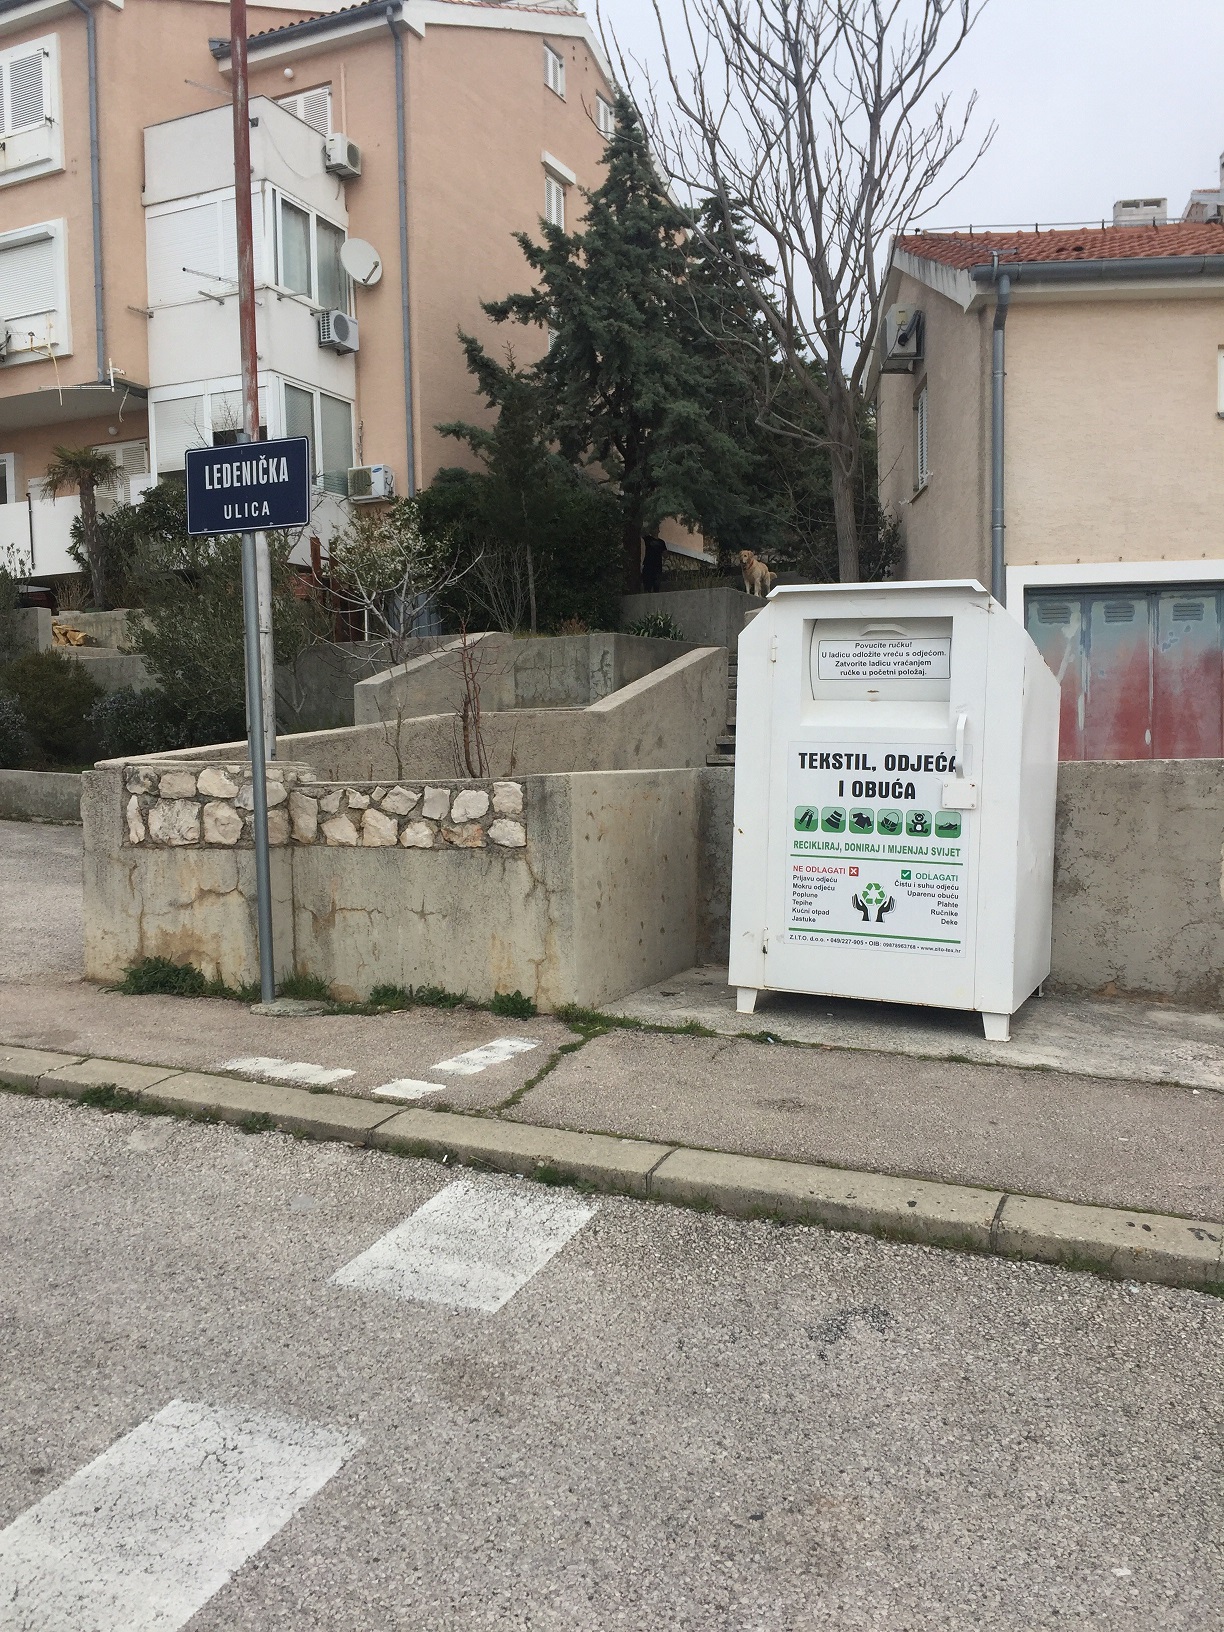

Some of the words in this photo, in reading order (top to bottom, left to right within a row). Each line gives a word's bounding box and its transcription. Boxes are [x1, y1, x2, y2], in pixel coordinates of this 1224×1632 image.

[205, 455, 288, 489] LEDENIČKA
[224, 501, 270, 519] ULICA
[912, 650, 946, 658] odjećom.
[869, 669, 896, 677] početni
[898, 669, 927, 677] položaj.
[799, 752, 877, 772] TEKSTIL,
[838, 780, 844, 797] I
[852, 778, 915, 799] OBUĆA
[793, 840, 842, 853] RECIKLIRAJ,
[844, 843, 880, 853] DONIRAJ
[882, 844, 885, 853] I
[887, 845, 928, 855] MIJENJAJ
[931, 847, 961, 857] SVIJET
[805, 866, 845, 874] ODLAGATI
[915, 872, 958, 881] ODLAGATI
